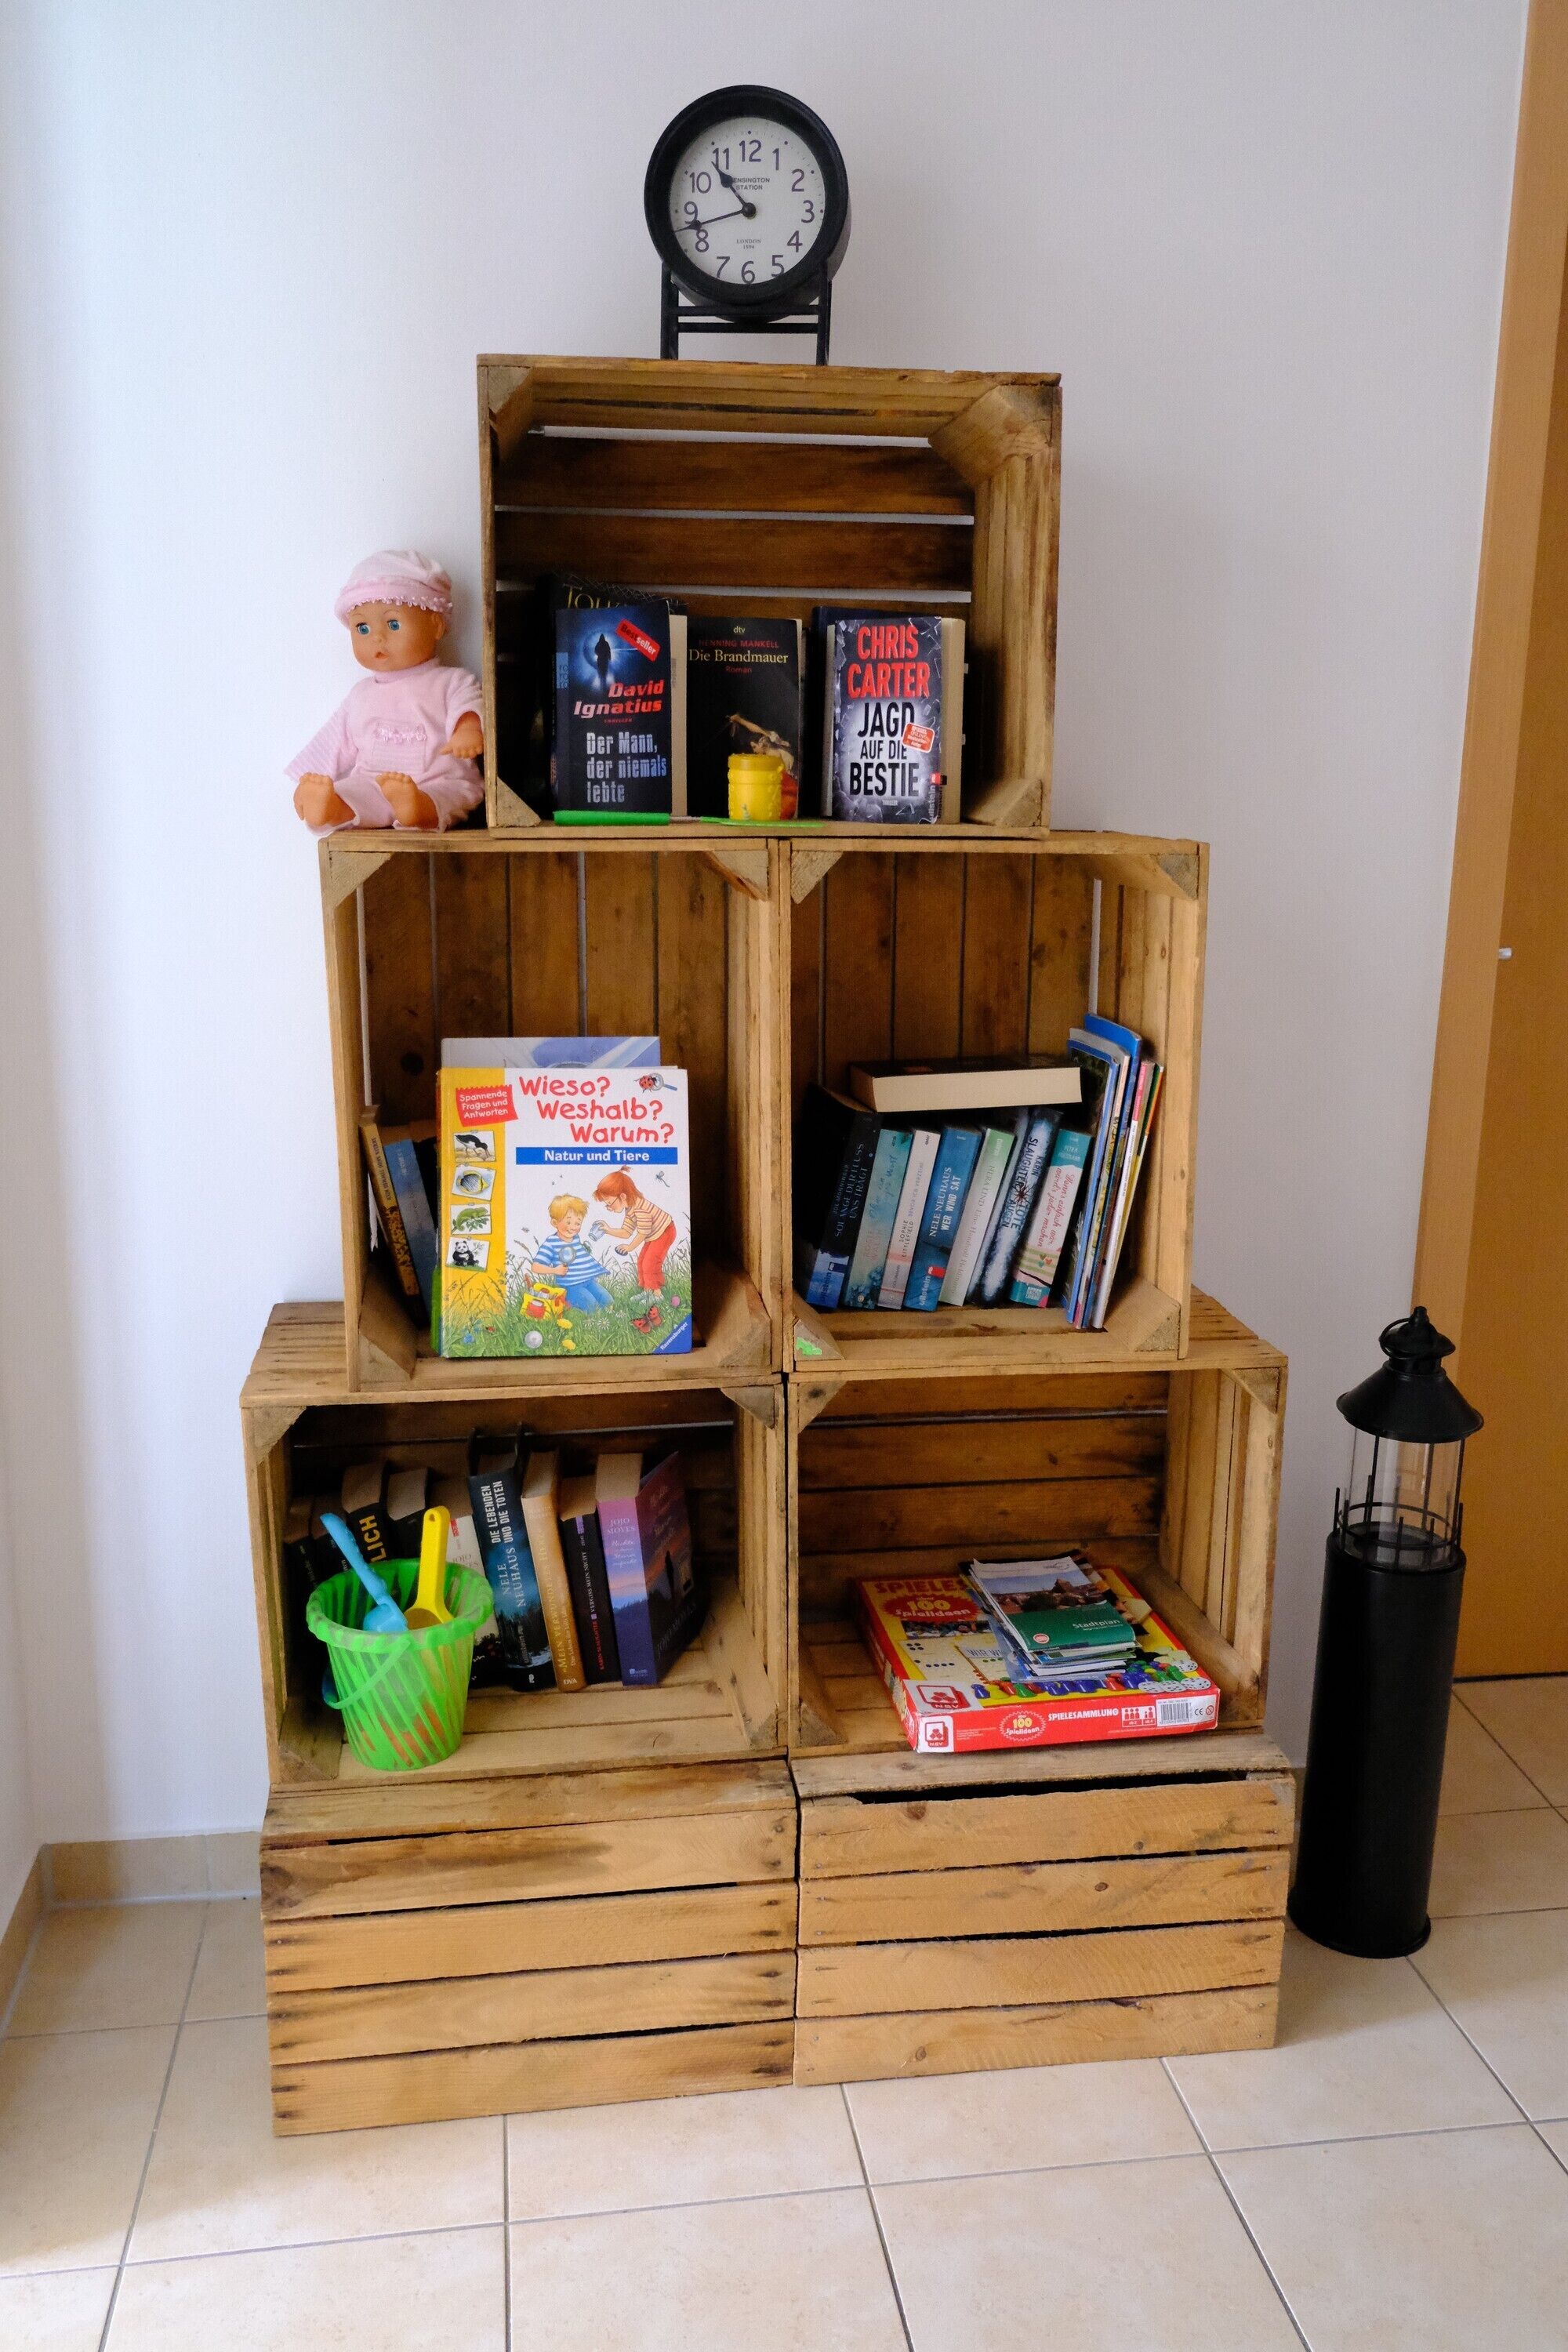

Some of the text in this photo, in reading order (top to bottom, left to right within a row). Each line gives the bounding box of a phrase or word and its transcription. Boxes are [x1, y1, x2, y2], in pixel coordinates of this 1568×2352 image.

[713, 148, 730, 170] 11
[739, 140, 761, 162] 12
[772, 148, 779, 171] 1
[689, 172, 712, 194] 10
[791, 169, 804, 192] 2
[684, 201, 698, 224] 9
[801, 200, 815, 223] 3
[695, 229, 710, 252] 8
[786, 230, 803, 252] 4
[716, 256, 731, 278] 7
[741, 260, 755, 284] 6
[771, 255, 785, 278] 5
[620, 622, 657, 655] Bestseller
[733, 626, 746, 635] dtv
[740, 640, 779, 649] MANKELL
[856, 625, 919, 660] CHRIS
[688, 648, 789, 663] Die Brandmauer
[608, 679, 665, 698] David
[848, 662, 931, 699] CARTER
[574, 699, 663, 718] Ignatius
[858, 702, 914, 738] JAGD
[586, 731, 657, 755] Der Mann,
[860, 739, 907, 760] AUF DIE
[586, 754, 667, 779] der niemals
[849, 762, 920, 797] BESTIE
[586, 781, 625, 804] lebte
[459, 1090, 507, 1102] Spannende
[519, 1075, 611, 1097] Wieso?
[462, 1098, 508, 1111] Fragen und
[463, 1108, 508, 1120] Antworten
[536, 1097, 663, 1120] Weshalb?
[570, 1123, 674, 1144] Warum?
[544, 1149, 650, 1162] Natur und Tiere
[1014, 1137, 1039, 1188] SLAUGHTER
[1033, 1156, 1044, 1177] KARIN
[929, 1167, 952, 1237] NELE NEUHAUS
[945, 1193, 958, 1213] WIND
[941, 1215, 953, 1231] WER
[1001, 1199, 1017, 1229] AUGEN
[898, 1219, 909, 1243] SOPHIE
[902, 1221, 915, 1258] LITTLEFIELD
[481, 1486, 502, 1544] DIE LEBENDEN
[493, 1480, 514, 1544] UND DIE TOTEN
[498, 1563, 510, 1596] NELE
[506, 1547, 527, 1608] NEUHAUS
[907, 1599, 951, 1611] 100
[1073, 1619, 1120, 1629] Stadtplan
[1012, 1717, 1033, 1728] 100
[1048, 1708, 1119, 1722] SPIELESAMMLUNG
